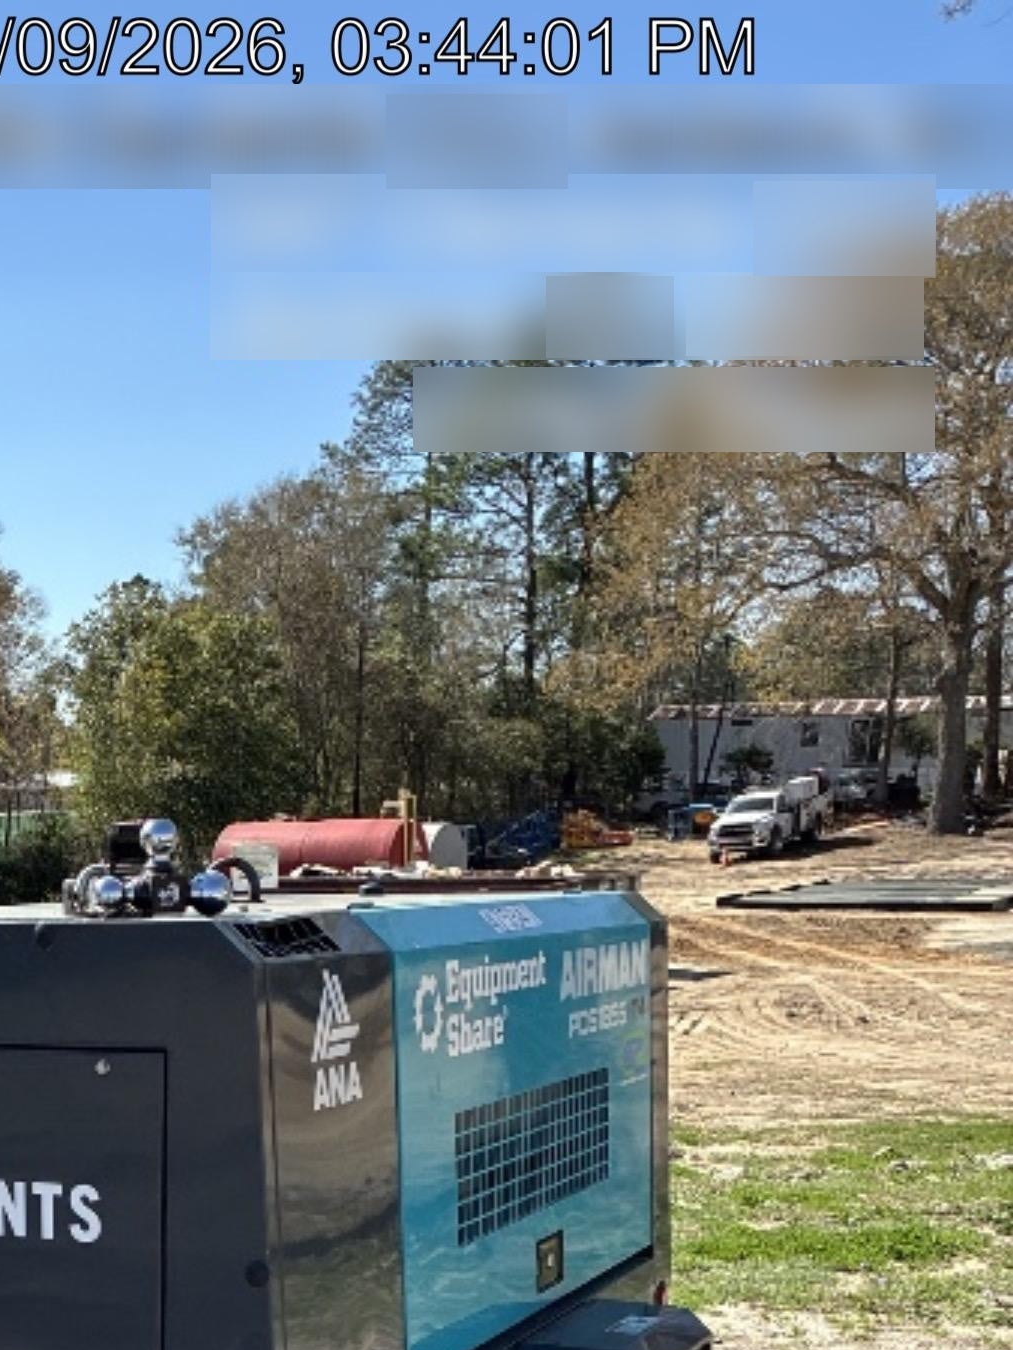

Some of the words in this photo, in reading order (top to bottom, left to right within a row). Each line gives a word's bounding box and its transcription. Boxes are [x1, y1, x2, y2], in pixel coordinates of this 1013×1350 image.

[445, 950, 547, 1011] Equipment
[559, 939, 649, 1003] AIRMAN
[313, 1061, 363, 1111] ANA
